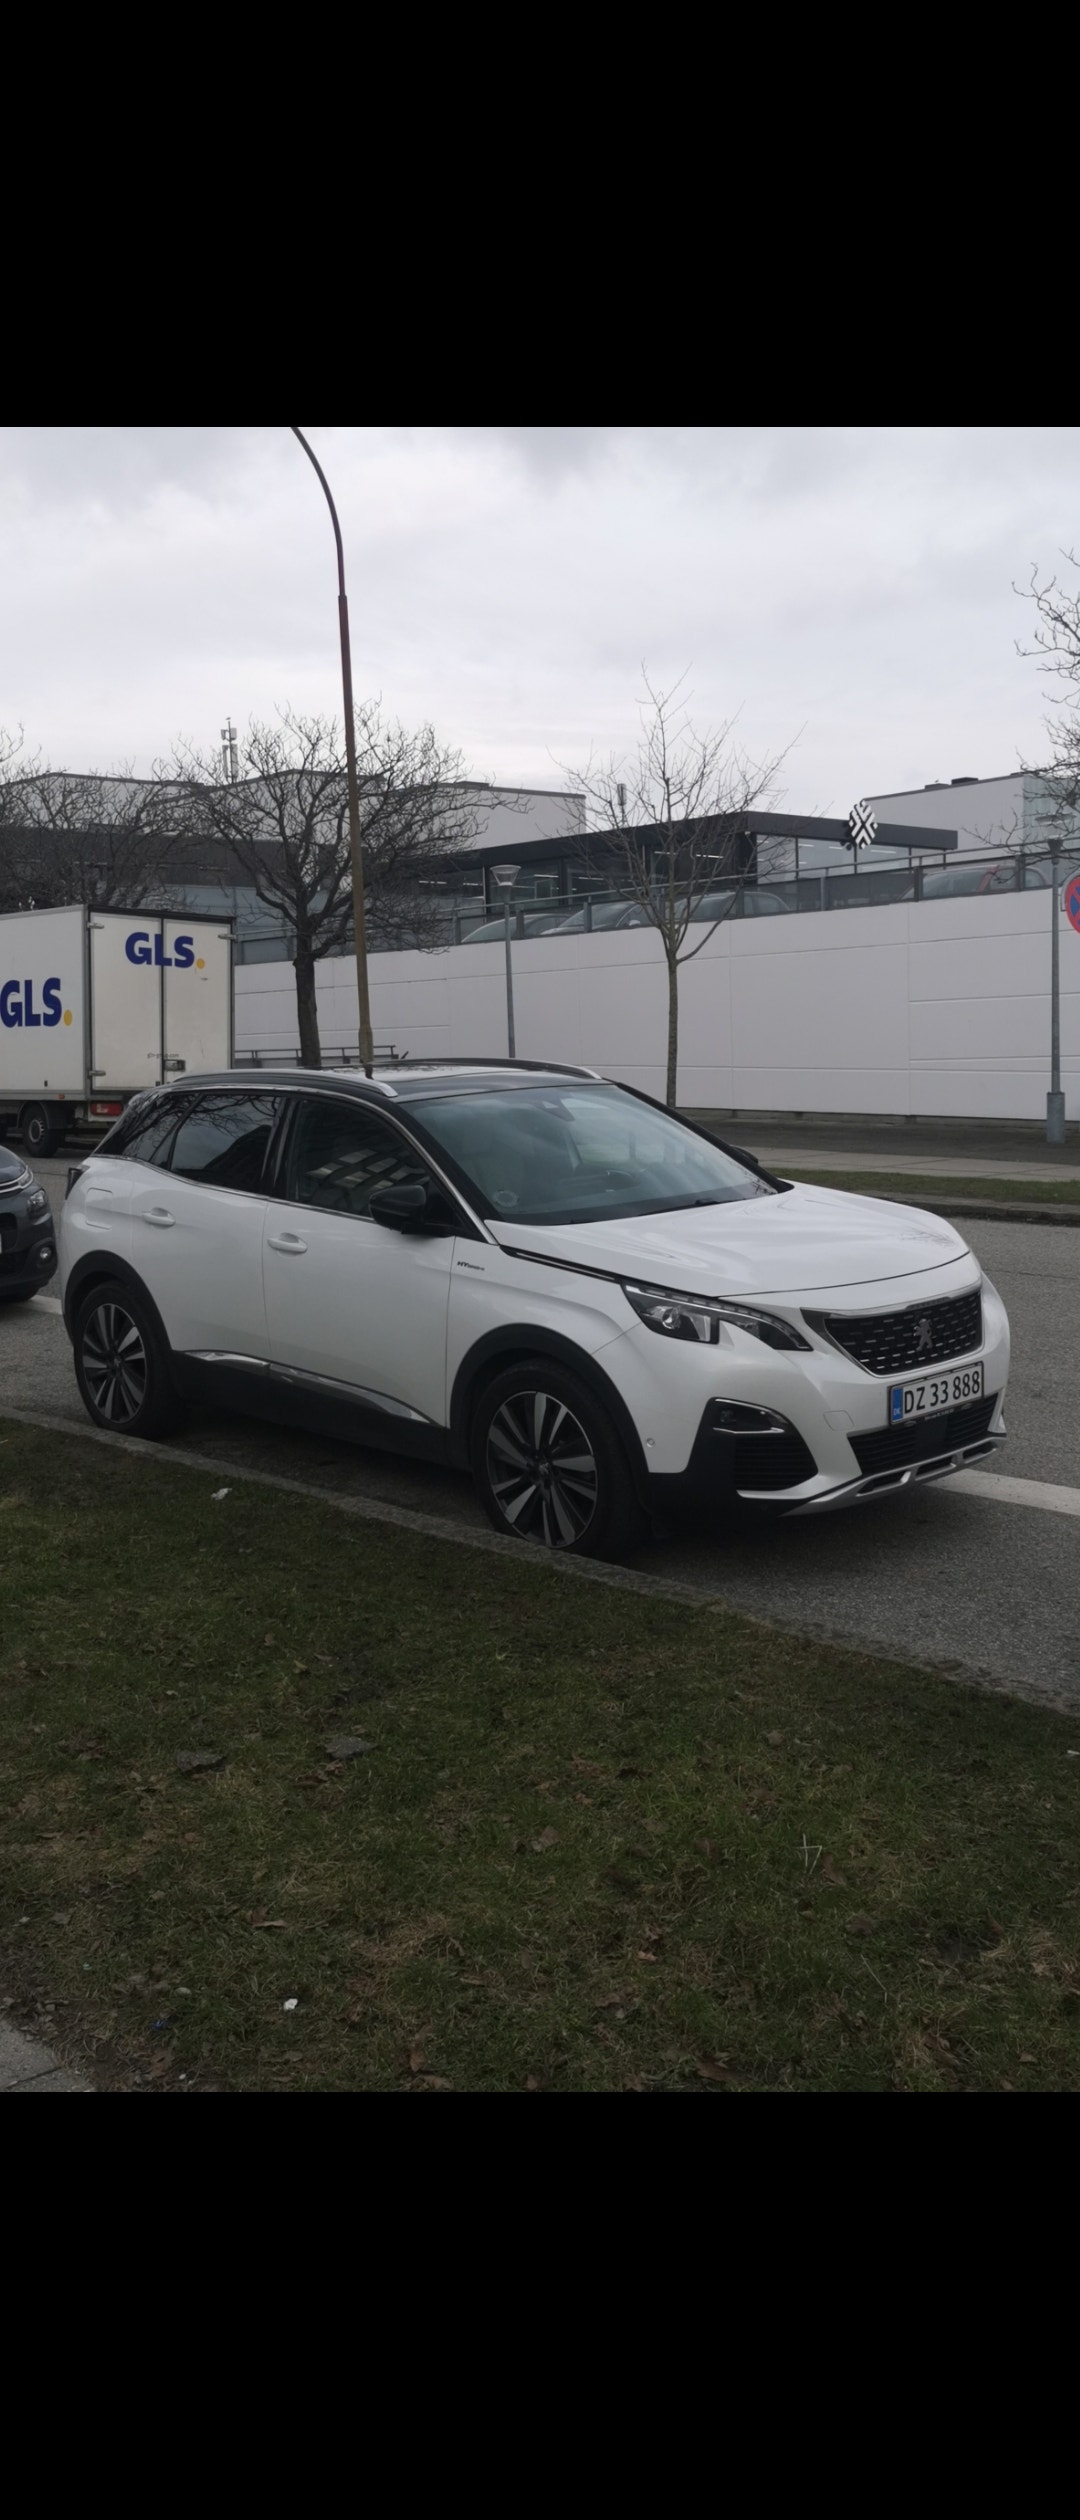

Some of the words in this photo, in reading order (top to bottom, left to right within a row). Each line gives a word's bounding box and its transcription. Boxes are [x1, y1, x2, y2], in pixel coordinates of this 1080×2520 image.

[904, 1386, 926, 1415] DZ
[930, 1380, 949, 1407] 33
[952, 1370, 981, 1401] 888
